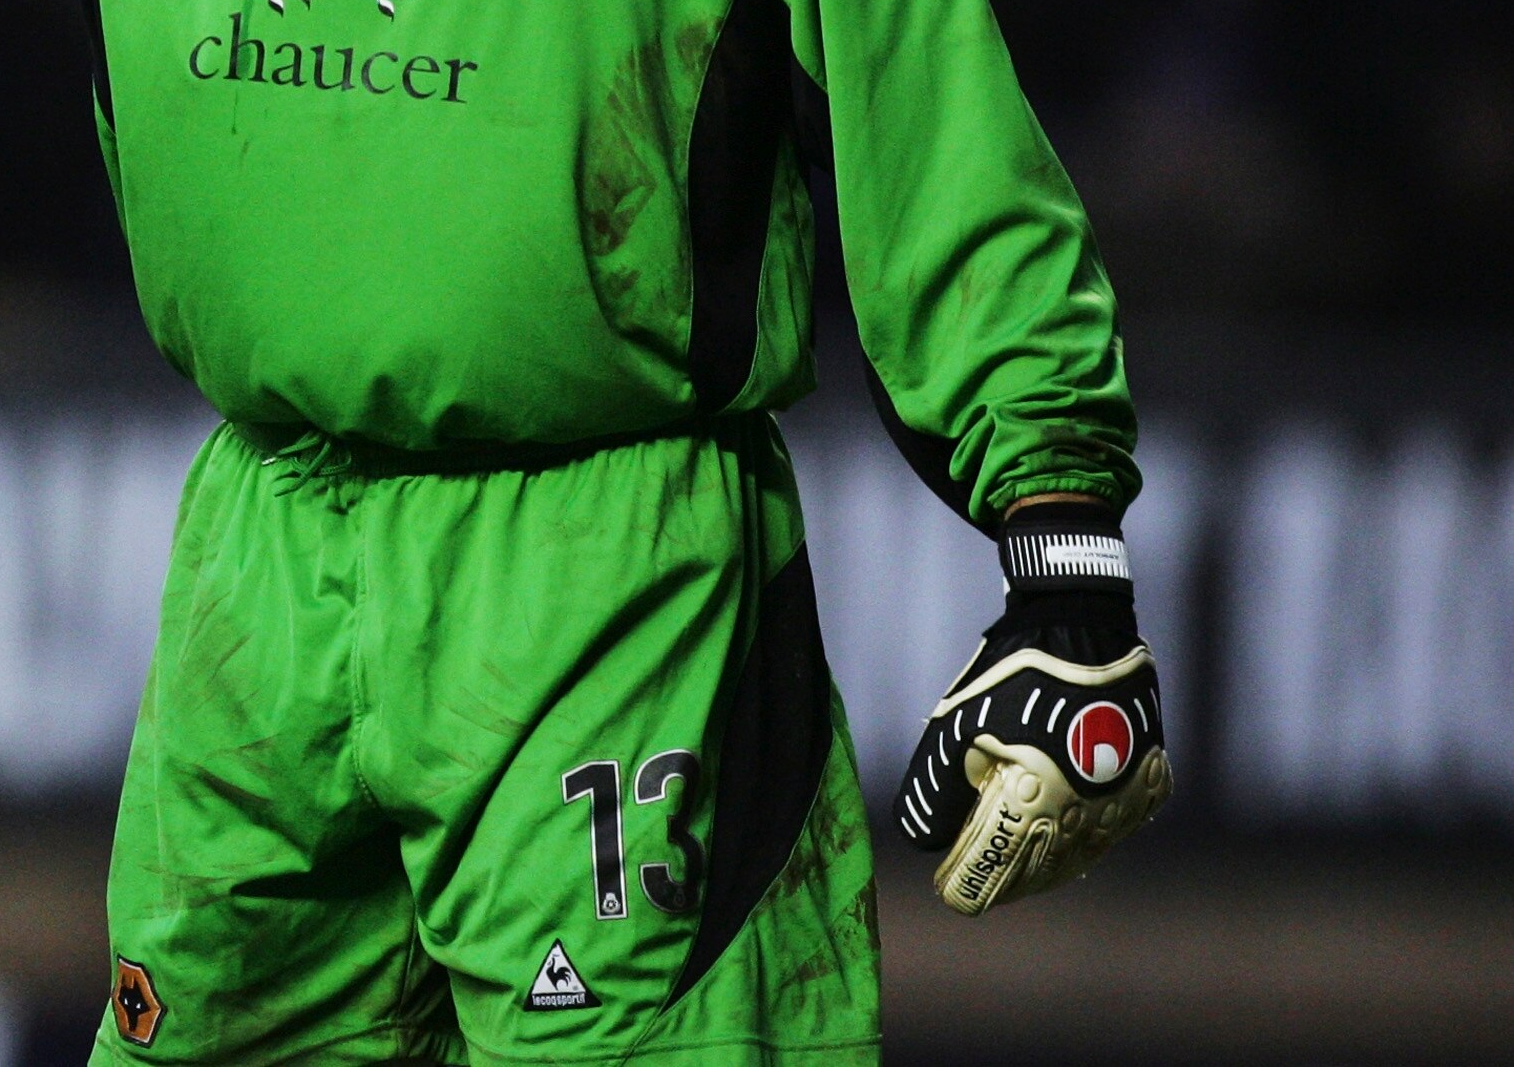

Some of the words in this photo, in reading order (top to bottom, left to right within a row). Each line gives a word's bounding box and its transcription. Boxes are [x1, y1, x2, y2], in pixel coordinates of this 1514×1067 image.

[189, 12, 478, 103] chaucer
[561, 748, 706, 920] 13
[959, 802, 1022, 900] uhlsport
